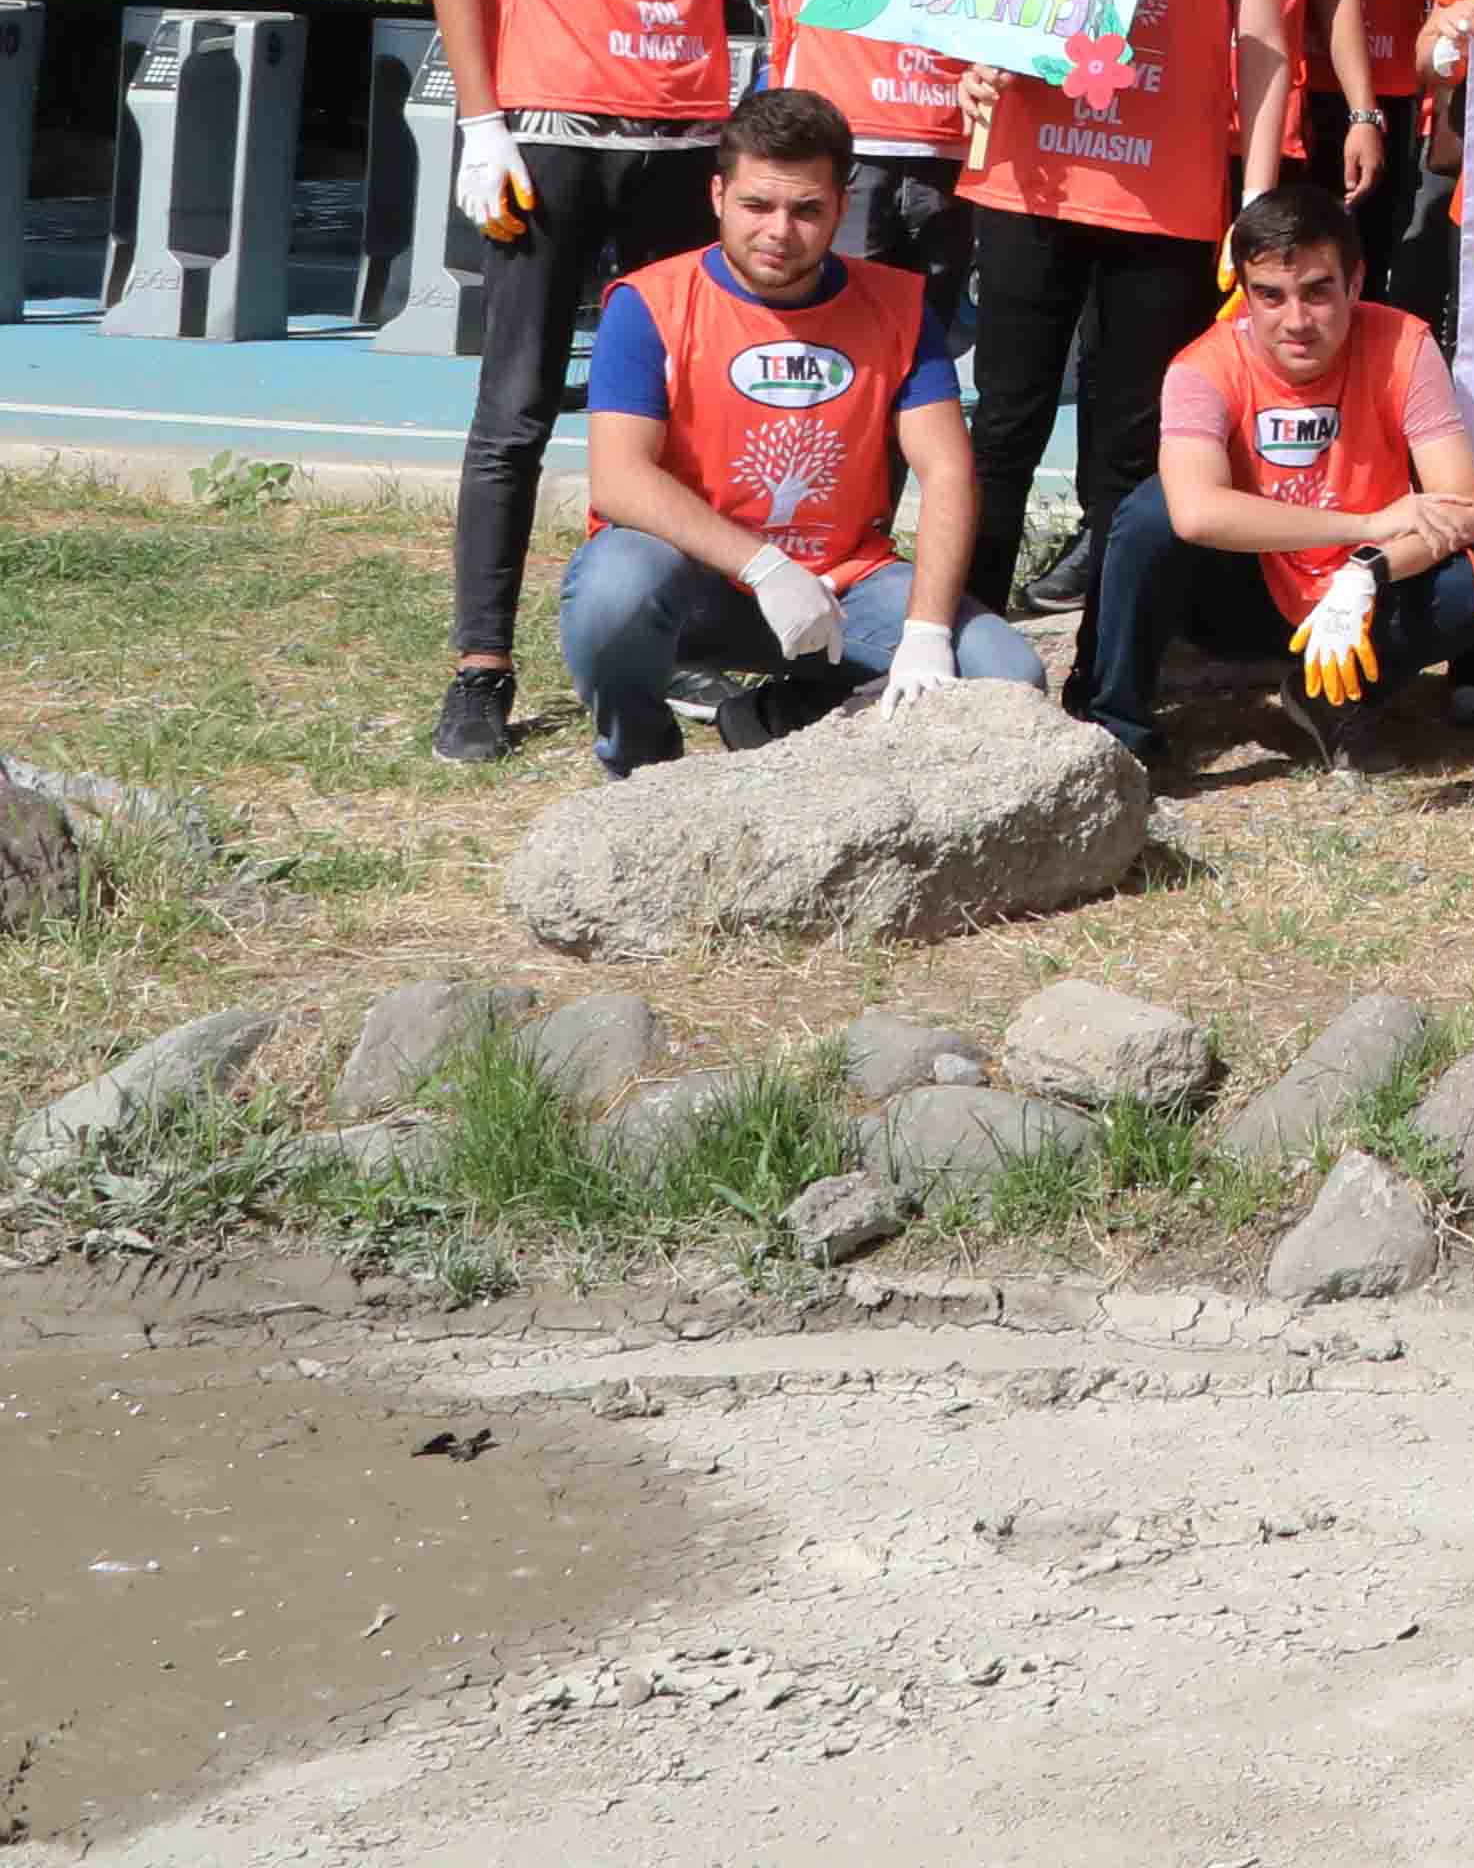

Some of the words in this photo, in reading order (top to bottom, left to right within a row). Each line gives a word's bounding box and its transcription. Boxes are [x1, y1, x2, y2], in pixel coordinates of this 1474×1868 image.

[1038, 125, 1153, 167] OLMASIN
[757, 355, 823, 381] TEMA
[1270, 417, 1336, 442] TEMA
